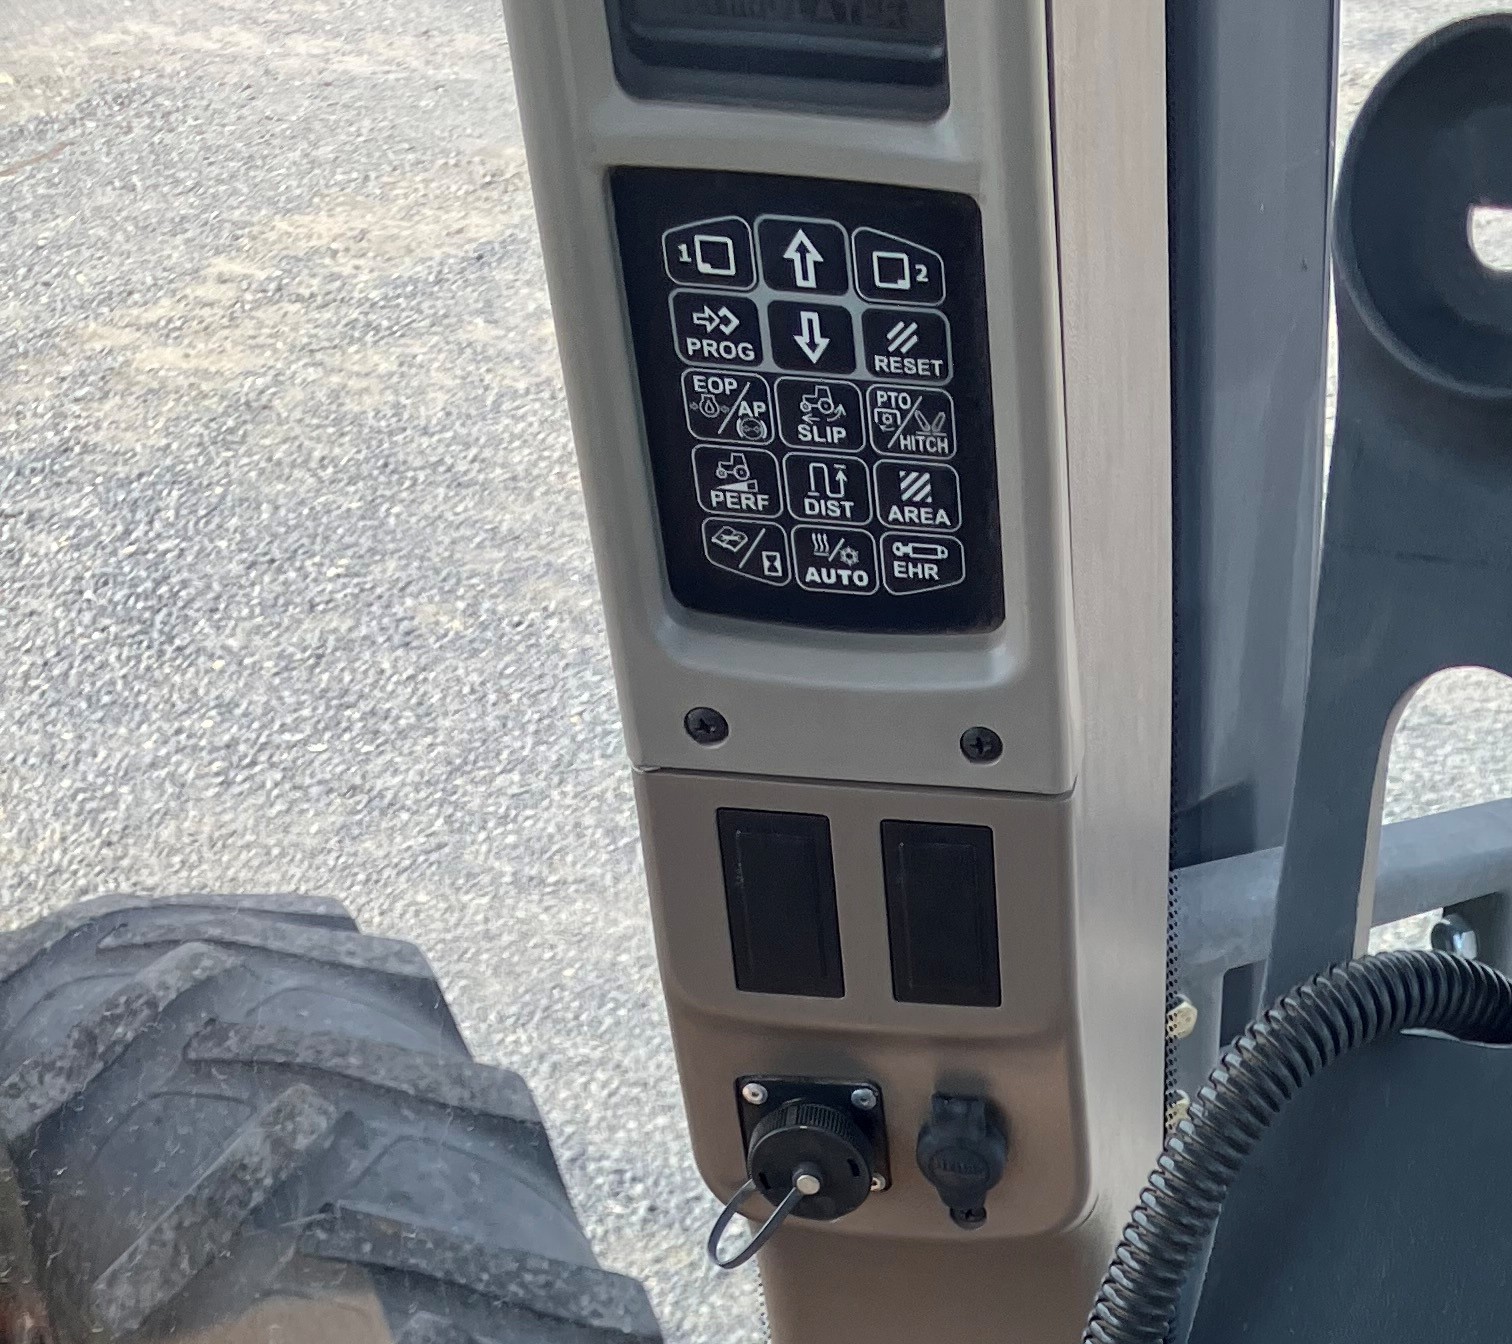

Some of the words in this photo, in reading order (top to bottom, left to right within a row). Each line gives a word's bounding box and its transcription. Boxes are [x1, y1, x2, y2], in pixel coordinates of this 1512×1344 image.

[677, 243, 692, 263] 1
[915, 264, 929, 283] 2
[686, 337, 755, 361] PROG
[874, 354, 944, 377] RESET
[692, 374, 738, 395] EOP
[738, 401, 766, 416] AP
[876, 390, 912, 410] PTO
[797, 423, 847, 444] SLIP
[900, 436, 948, 454] HITCH
[710, 489, 770, 511] PERF
[803, 498, 855, 519] DIST
[888, 507, 950, 526] AREA
[805, 566, 869, 587] AUTO
[893, 560, 939, 581] EHR
